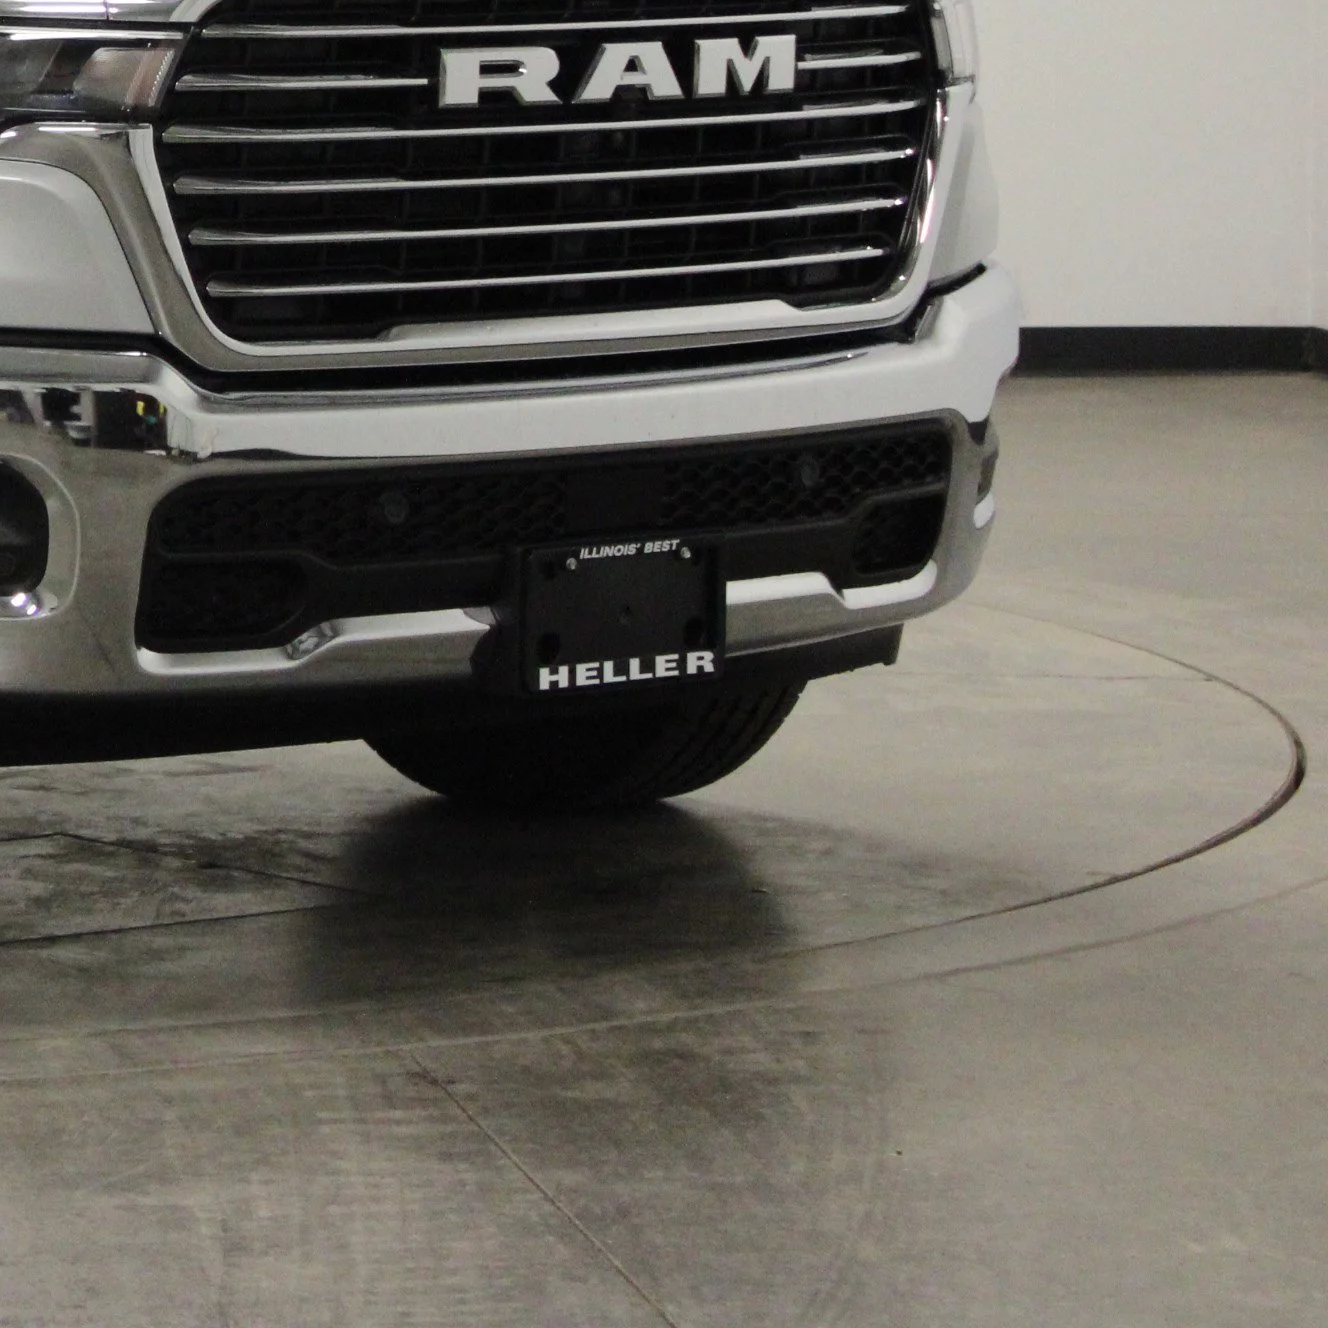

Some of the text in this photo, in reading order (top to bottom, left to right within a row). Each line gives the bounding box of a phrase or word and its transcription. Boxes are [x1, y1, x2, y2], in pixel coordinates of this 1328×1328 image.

[438, 34, 796, 109] RAM
[644, 539, 680, 554] BEST
[538, 650, 715, 691] HELLER
